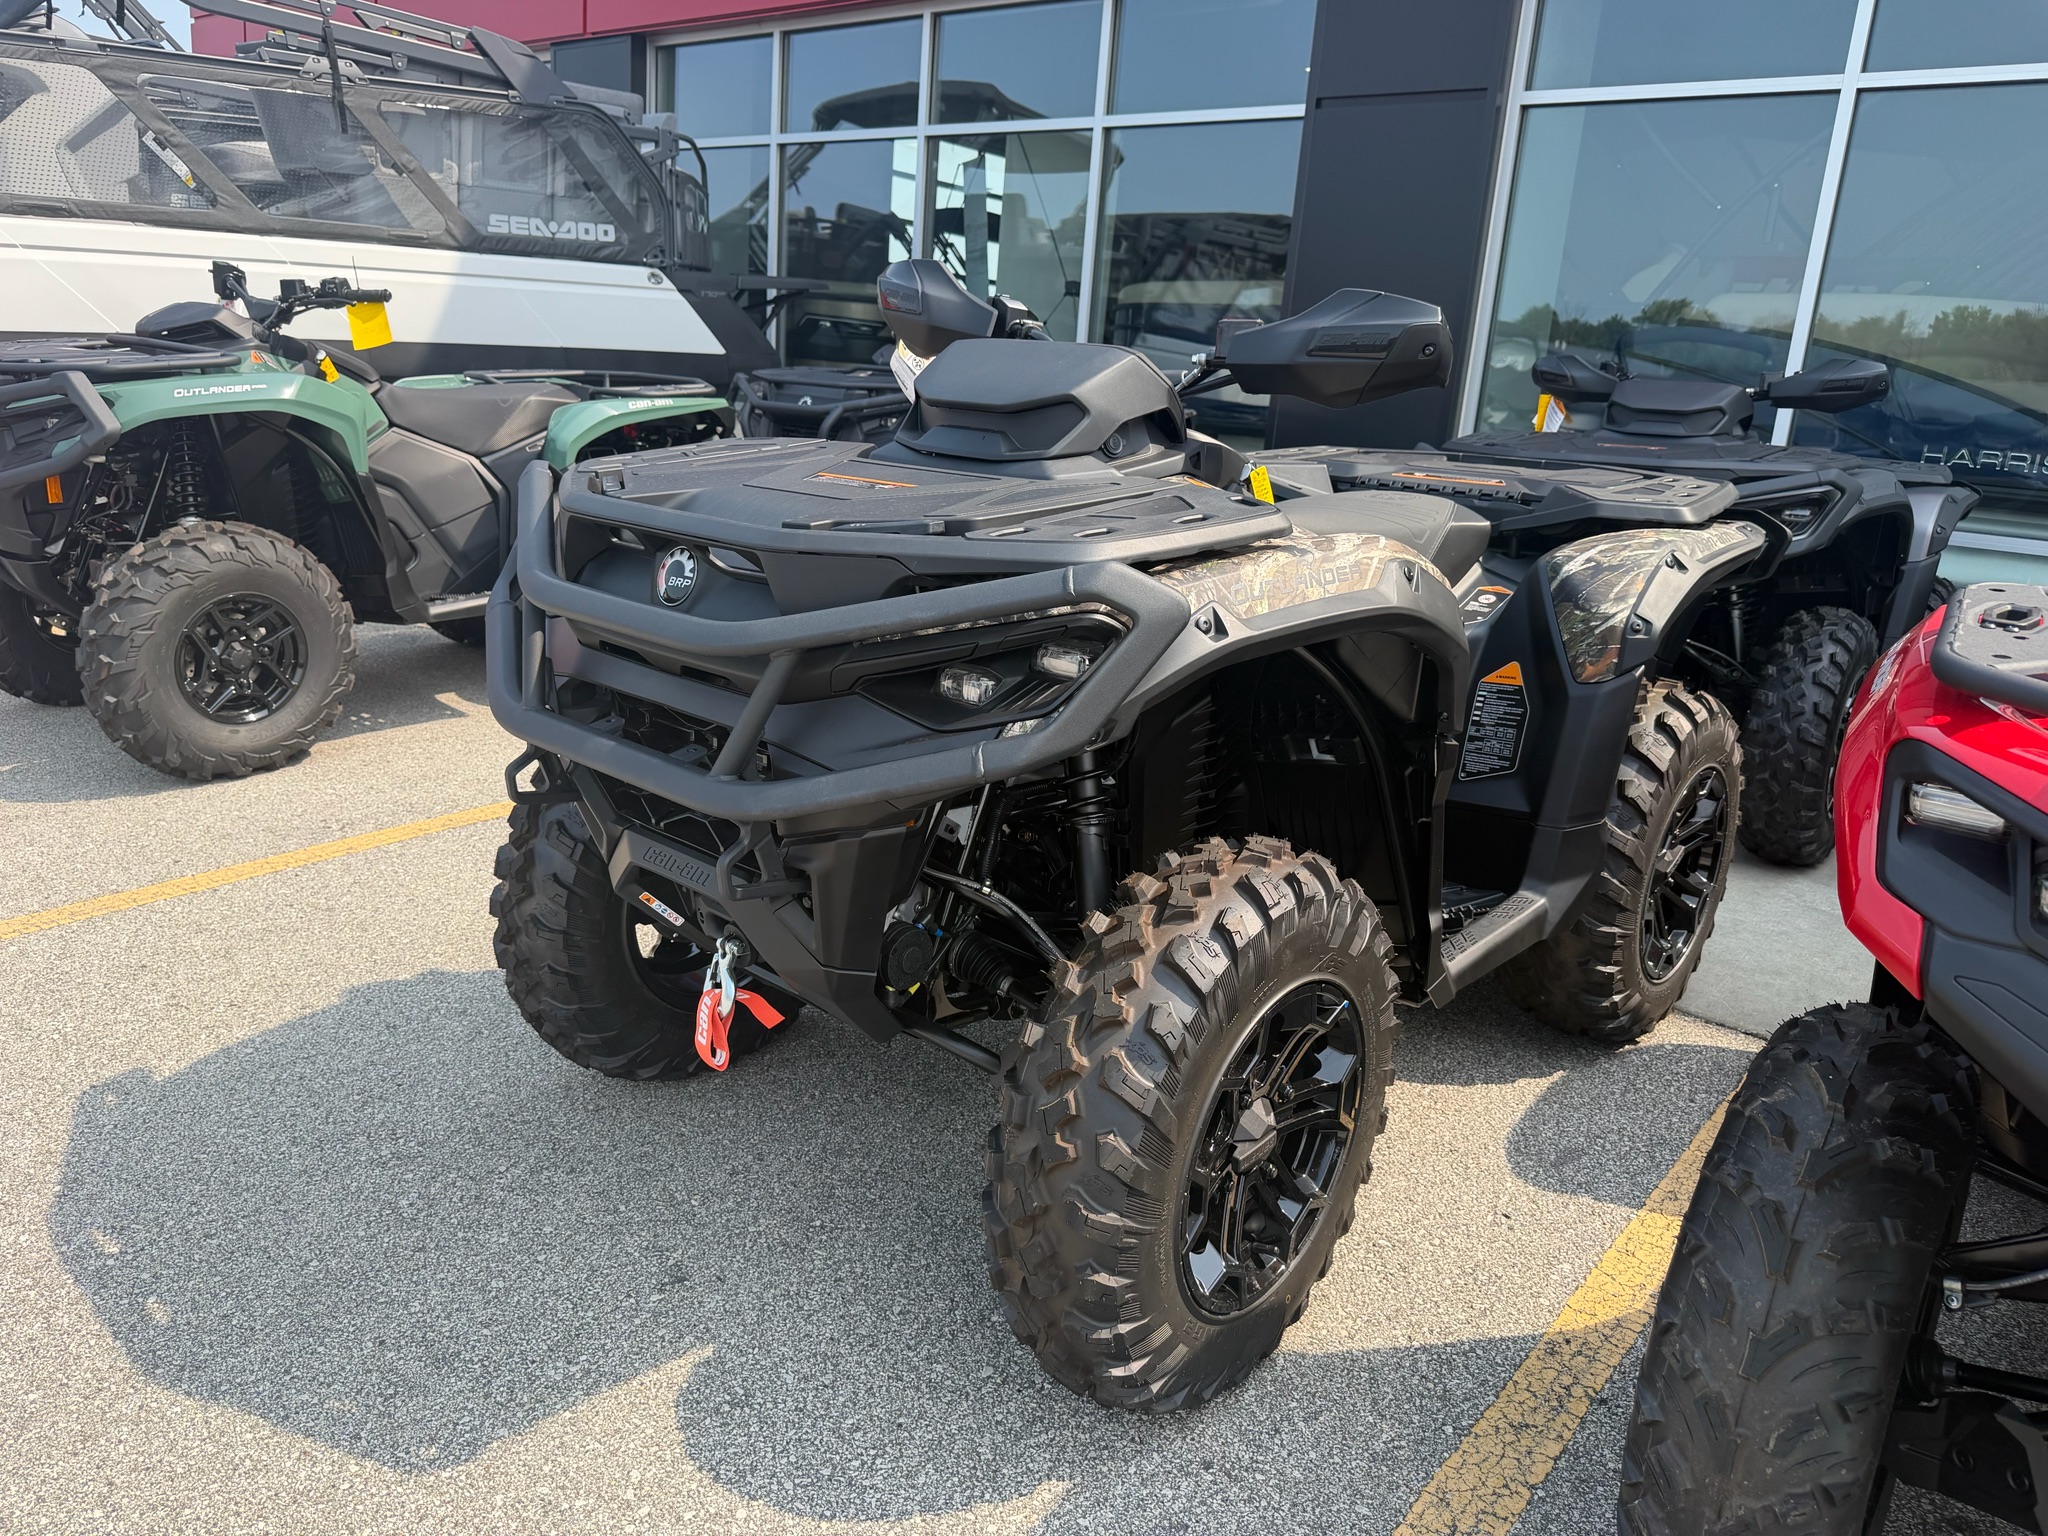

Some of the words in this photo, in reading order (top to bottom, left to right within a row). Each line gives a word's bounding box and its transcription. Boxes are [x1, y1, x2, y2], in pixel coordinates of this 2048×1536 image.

[174, 384, 252, 398] OUTLANDER
[628, 399, 674, 410] can-am
[667, 576, 692, 588] BRP
[1230, 562, 1362, 606] OUTLANDER
[642, 845, 712, 888] can-am
